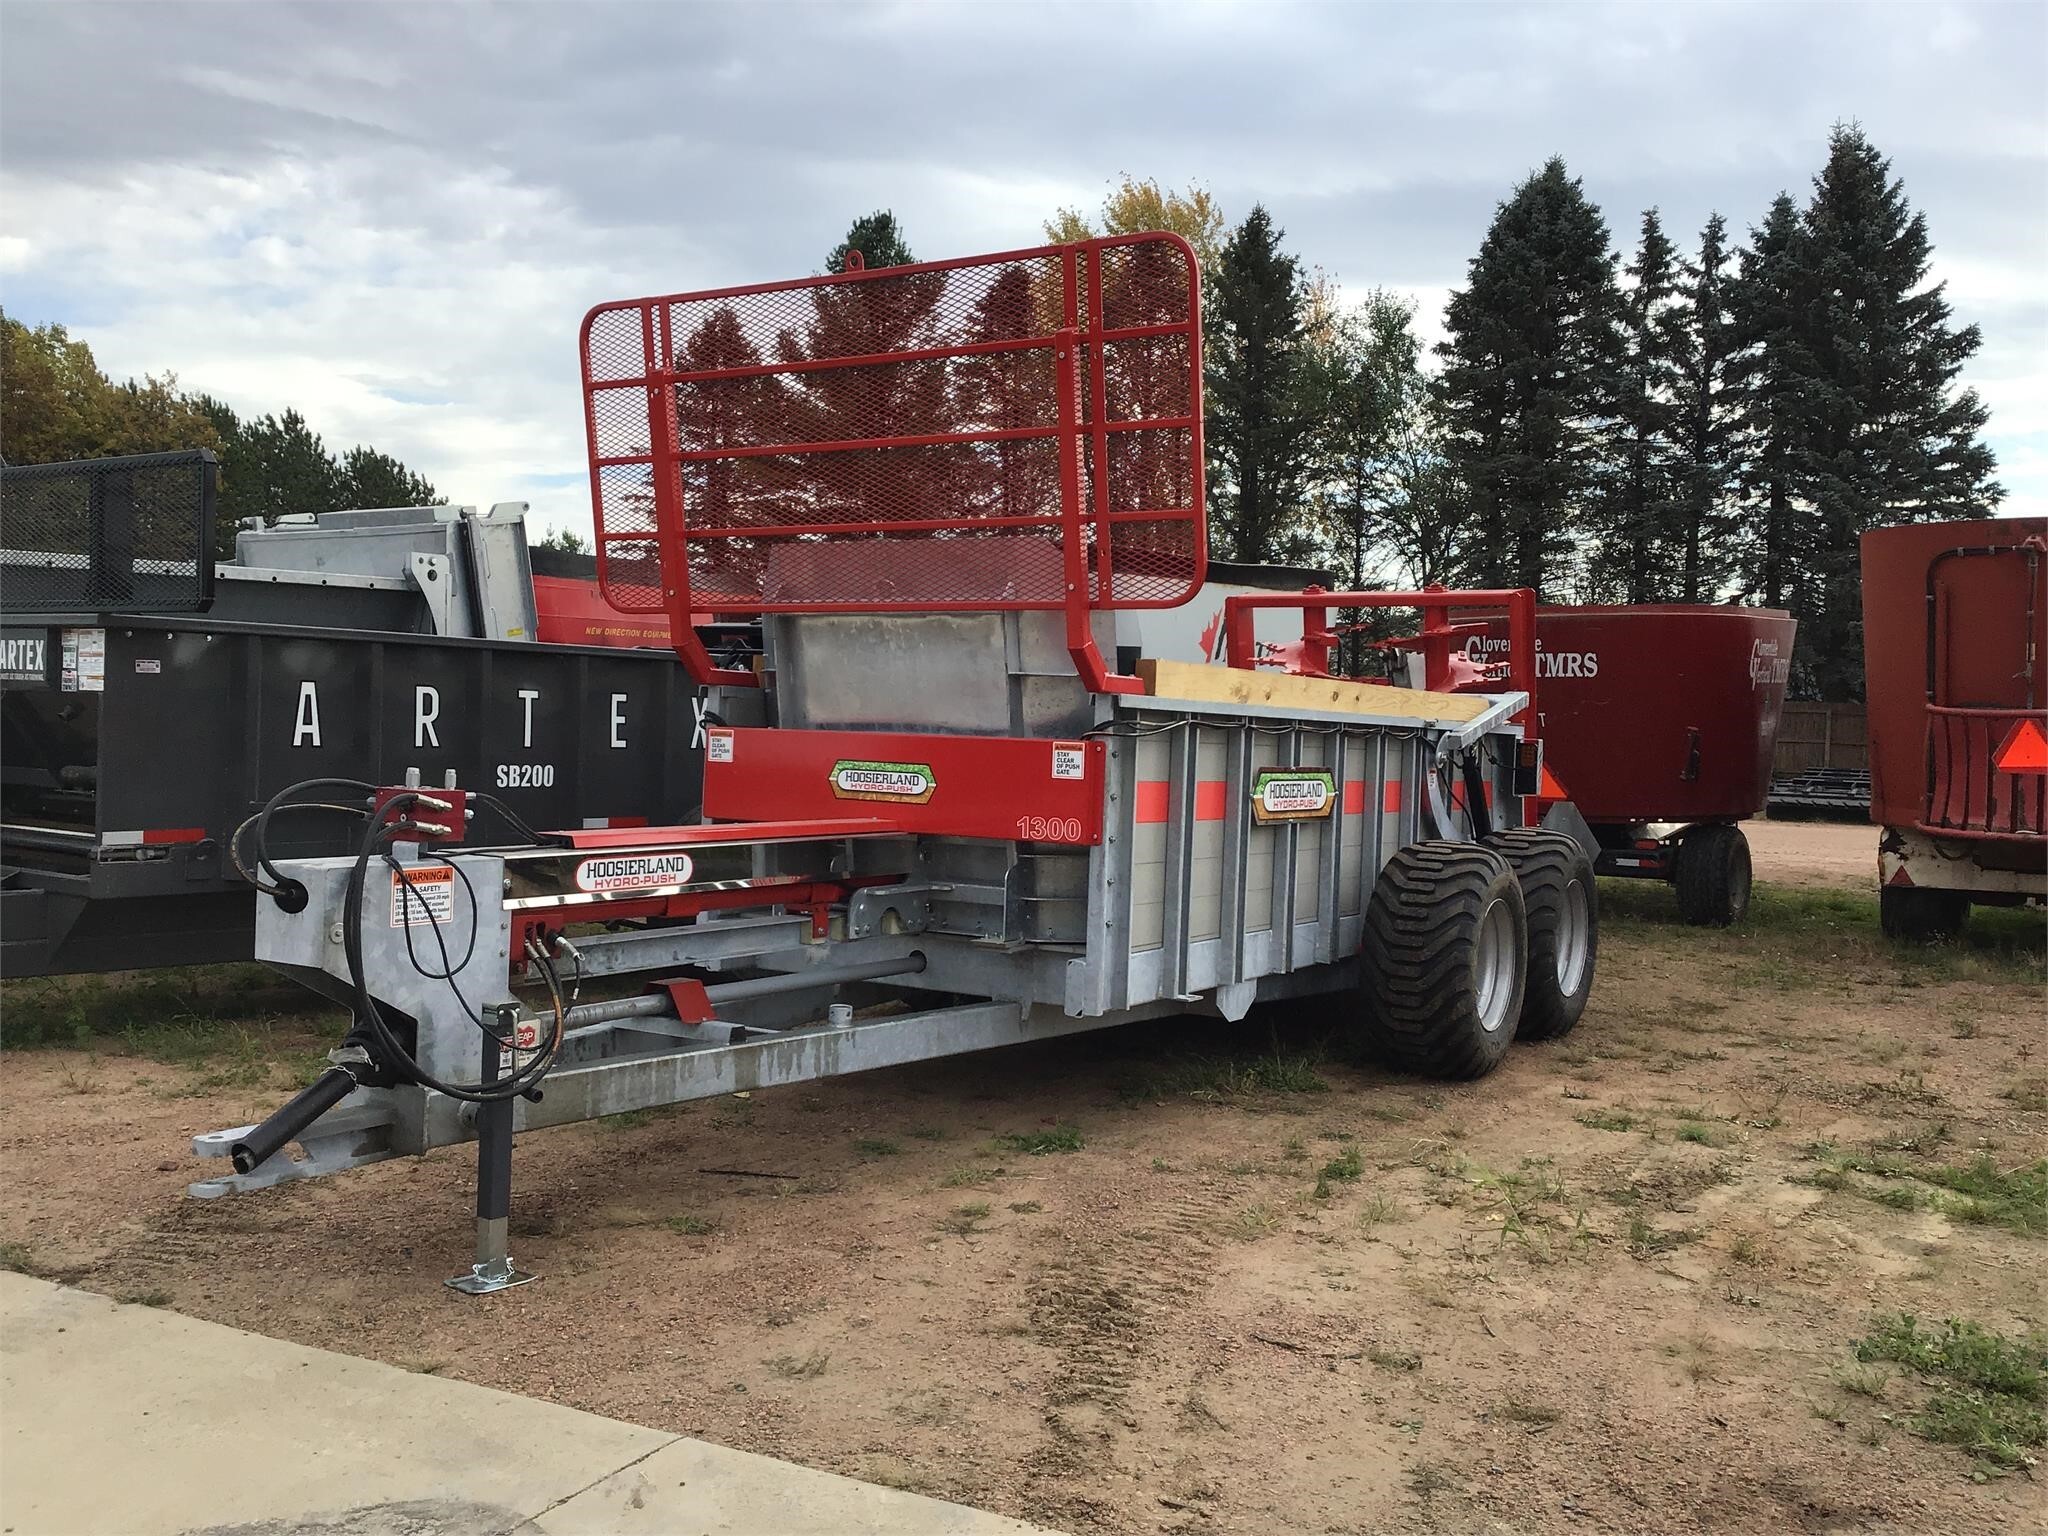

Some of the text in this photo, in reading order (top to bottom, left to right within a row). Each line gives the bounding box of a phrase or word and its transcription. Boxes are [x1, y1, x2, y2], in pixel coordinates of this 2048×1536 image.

[585, 627, 672, 640] NEW DIRECTION EQUIPME
[0, 640, 44, 670] ARTEX
[496, 764, 554, 788] SB200
[845, 771, 919, 786] HOOSIERLAND
[850, 783, 913, 792] HYDRO-PUSH
[1269, 783, 1322, 799] HOOSIERLAND
[1273, 799, 1318, 809] HYDRO-PUSH
[1016, 815, 1082, 842] 1300
[586, 856, 684, 879] HOOSIERLAND
[405, 871, 442, 881] WARNING
[594, 874, 677, 889] HYDRO-PUSH
